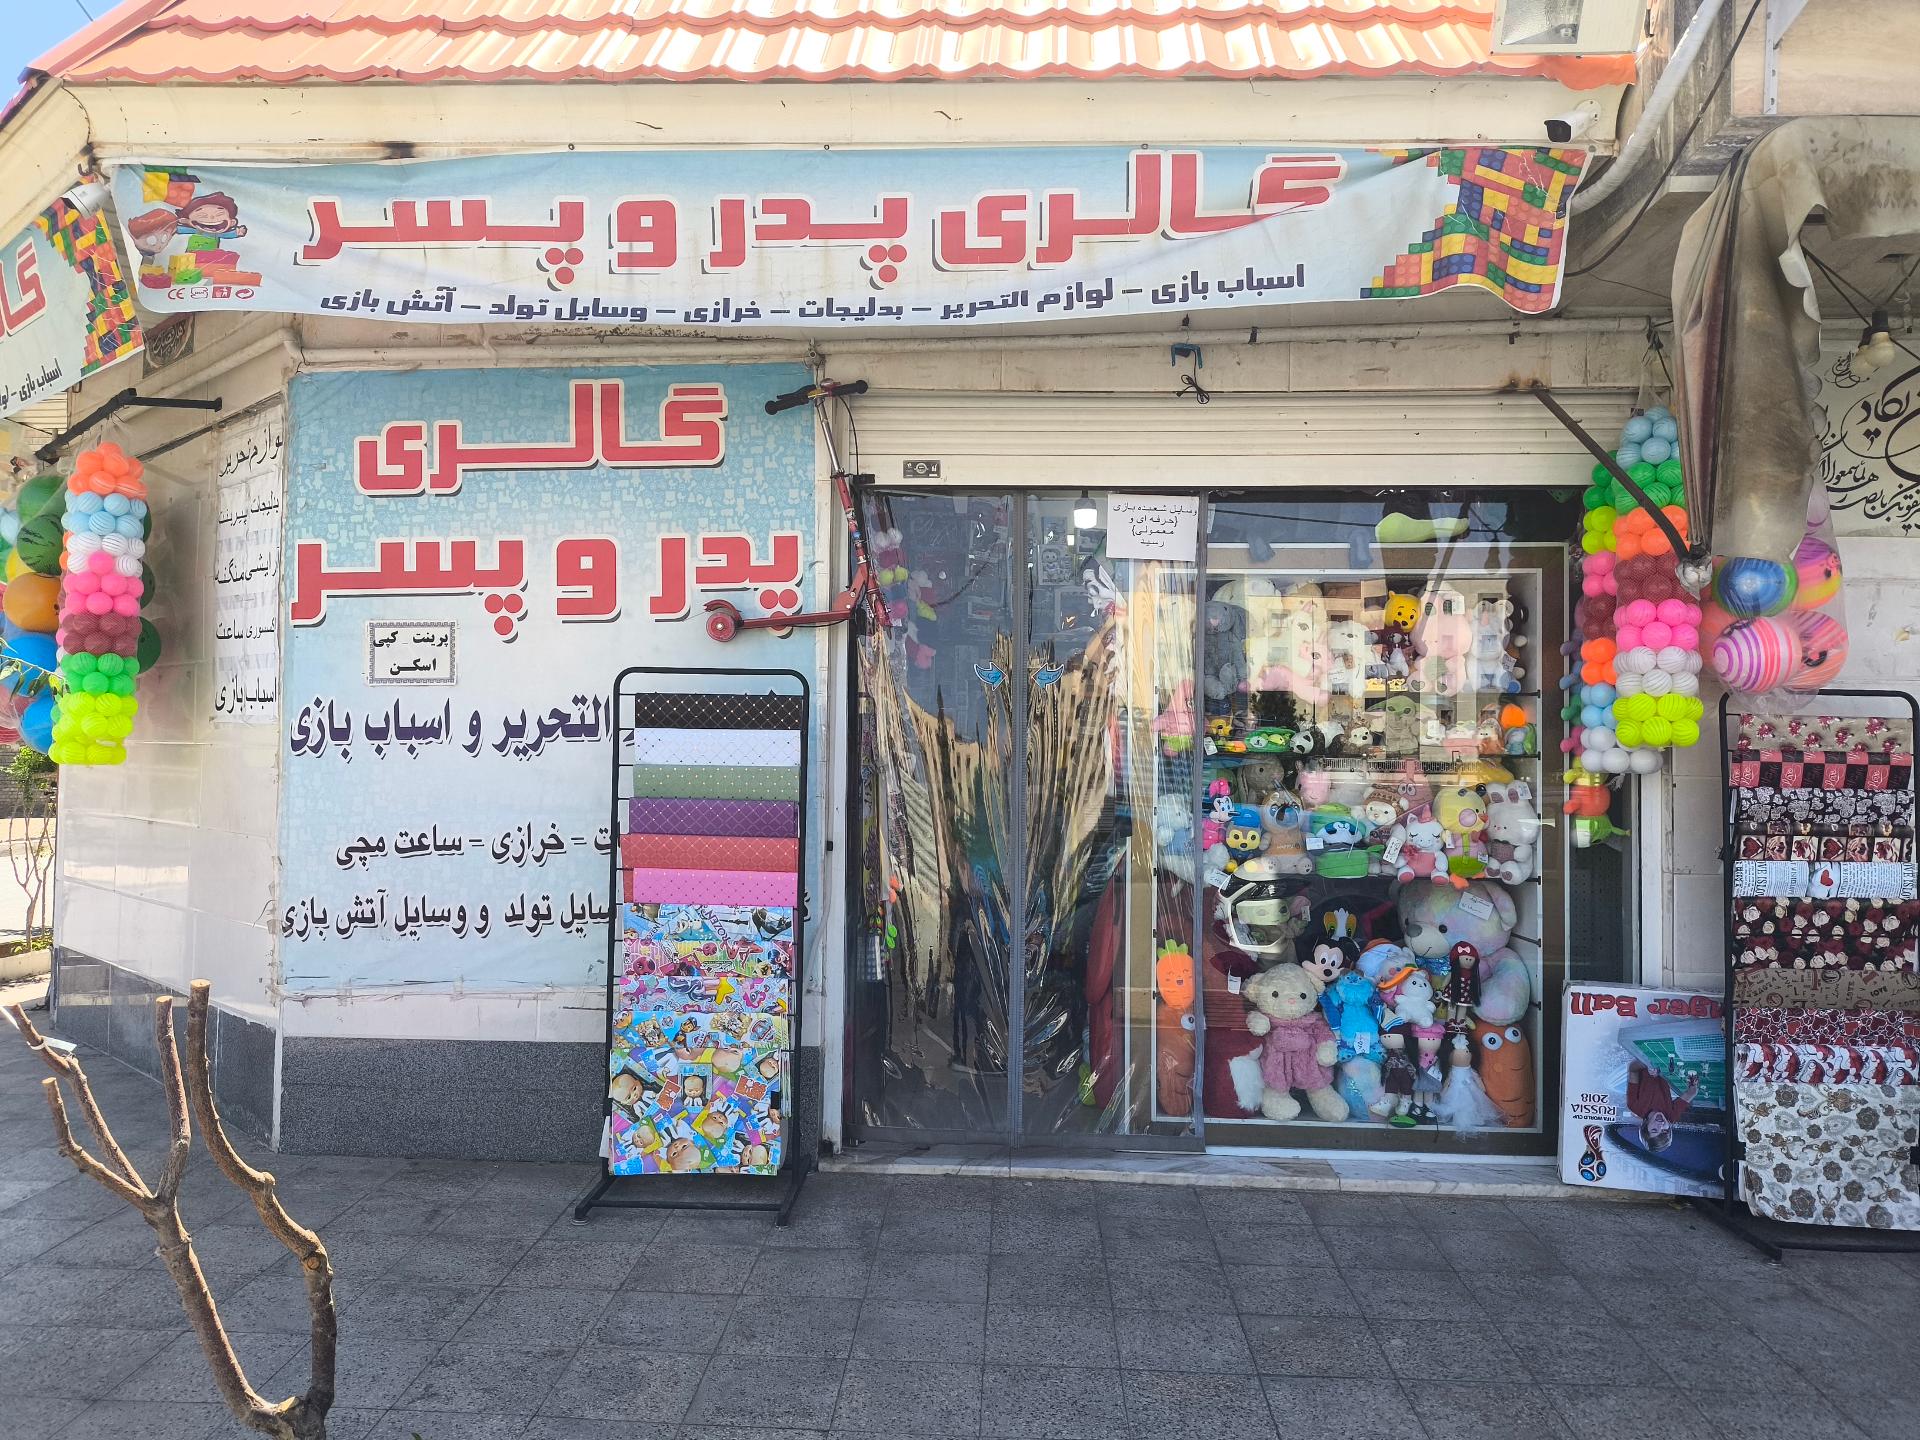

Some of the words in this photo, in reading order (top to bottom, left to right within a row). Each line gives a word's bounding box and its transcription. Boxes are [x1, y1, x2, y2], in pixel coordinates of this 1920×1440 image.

[939, 152, 1343, 266] گالری
[302, 198, 585, 285] پسر
[616, 199, 678, 268] و
[708, 197, 909, 283] پدر
[1036, 277, 1114, 313] لوازم
[1150, 270, 1209, 305] بازی
[1217, 262, 1305, 299] اسباب
[320, 288, 380, 313] بازی
[386, 286, 457, 315] آتش
[488, 294, 551, 320] تولد
[554, 297, 649, 322] وسایل
[683, 296, 762, 323] خرازی
[798, 296, 904, 322] بدلیجات
[939, 289, 1029, 321] التحریر
[19, 372, 37, 402] بازی
[36, 357, 63, 392] اسباب
[250, 421, 284, 470] وازم
[356, 382, 725, 492] گالری
[1112, 502, 1136, 513] بازی
[1169, 504, 1198, 516] وسایل
[290, 537, 526, 637] پسر
[556, 537, 617, 616] و
[215, 618, 244, 640] ساعت
[372, 630, 399, 648] کپی
[412, 631, 449, 648] پرینت
[389, 657, 437, 676] اسکن
[214, 674, 246, 714] بازی
[245, 676, 278, 710] اسباب
[289, 695, 353, 764] بازی
[364, 697, 452, 759] اسباب
[461, 708, 483, 757] و
[492, 693, 612, 761] التحریر
[336, 832, 388, 872] مچی
[394, 823, 464, 858] ساعت
[491, 821, 566, 868] خرازی
[280, 895, 329, 941] بازی
[334, 888, 389, 939] آتش
[393, 894, 469, 941] وسایل
[474, 903, 492, 939] و
[504, 892, 554, 937] تولد
[559, 892, 618, 939] سایل
[1570, 991, 1638, 1018] Ball
[1570, 1103, 1616, 1116] RUSSIA
[1580, 1093, 1609, 1104] 2018
